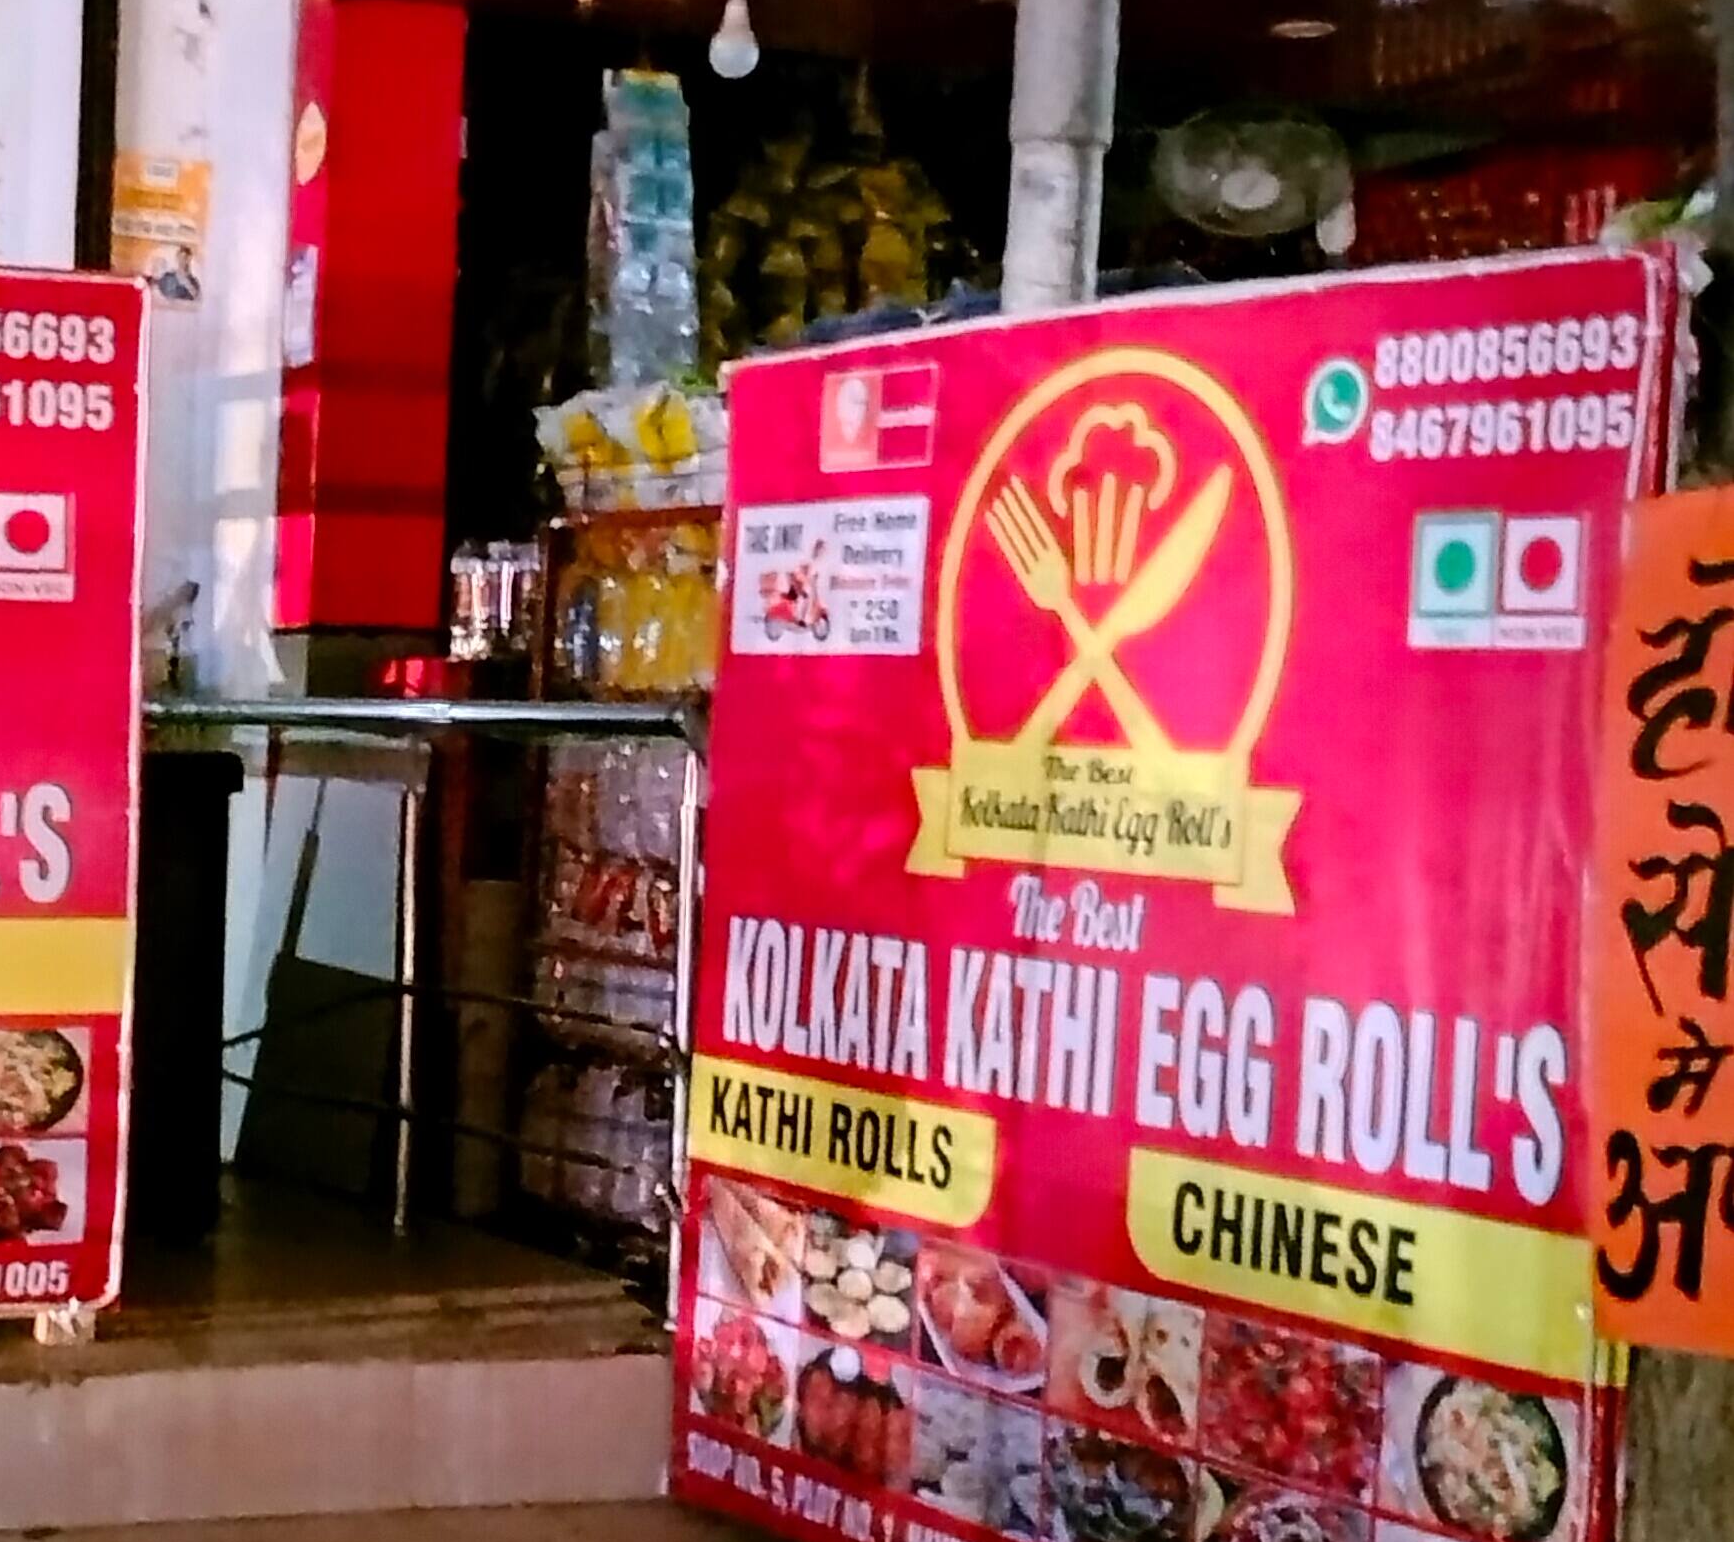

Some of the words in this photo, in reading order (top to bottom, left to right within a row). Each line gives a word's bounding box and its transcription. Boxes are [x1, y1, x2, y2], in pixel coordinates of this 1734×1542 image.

[1375, 313, 1640, 389] 8800856693
[1370, 392, 1635, 462] 8467961095
[1009, 871, 1066, 943] The
[1071, 879, 1146, 952] Best
[722, 915, 928, 1081] KOLKATA
[943, 945, 1120, 1117] KATHI
[1136, 974, 1275, 1149] EGG
[1296, 997, 1568, 1207] ROLL'S
[710, 1075, 813, 1156] KATHI
[829, 1102, 954, 1189] ROLLS
[1172, 1181, 1417, 1306] CHINESE
